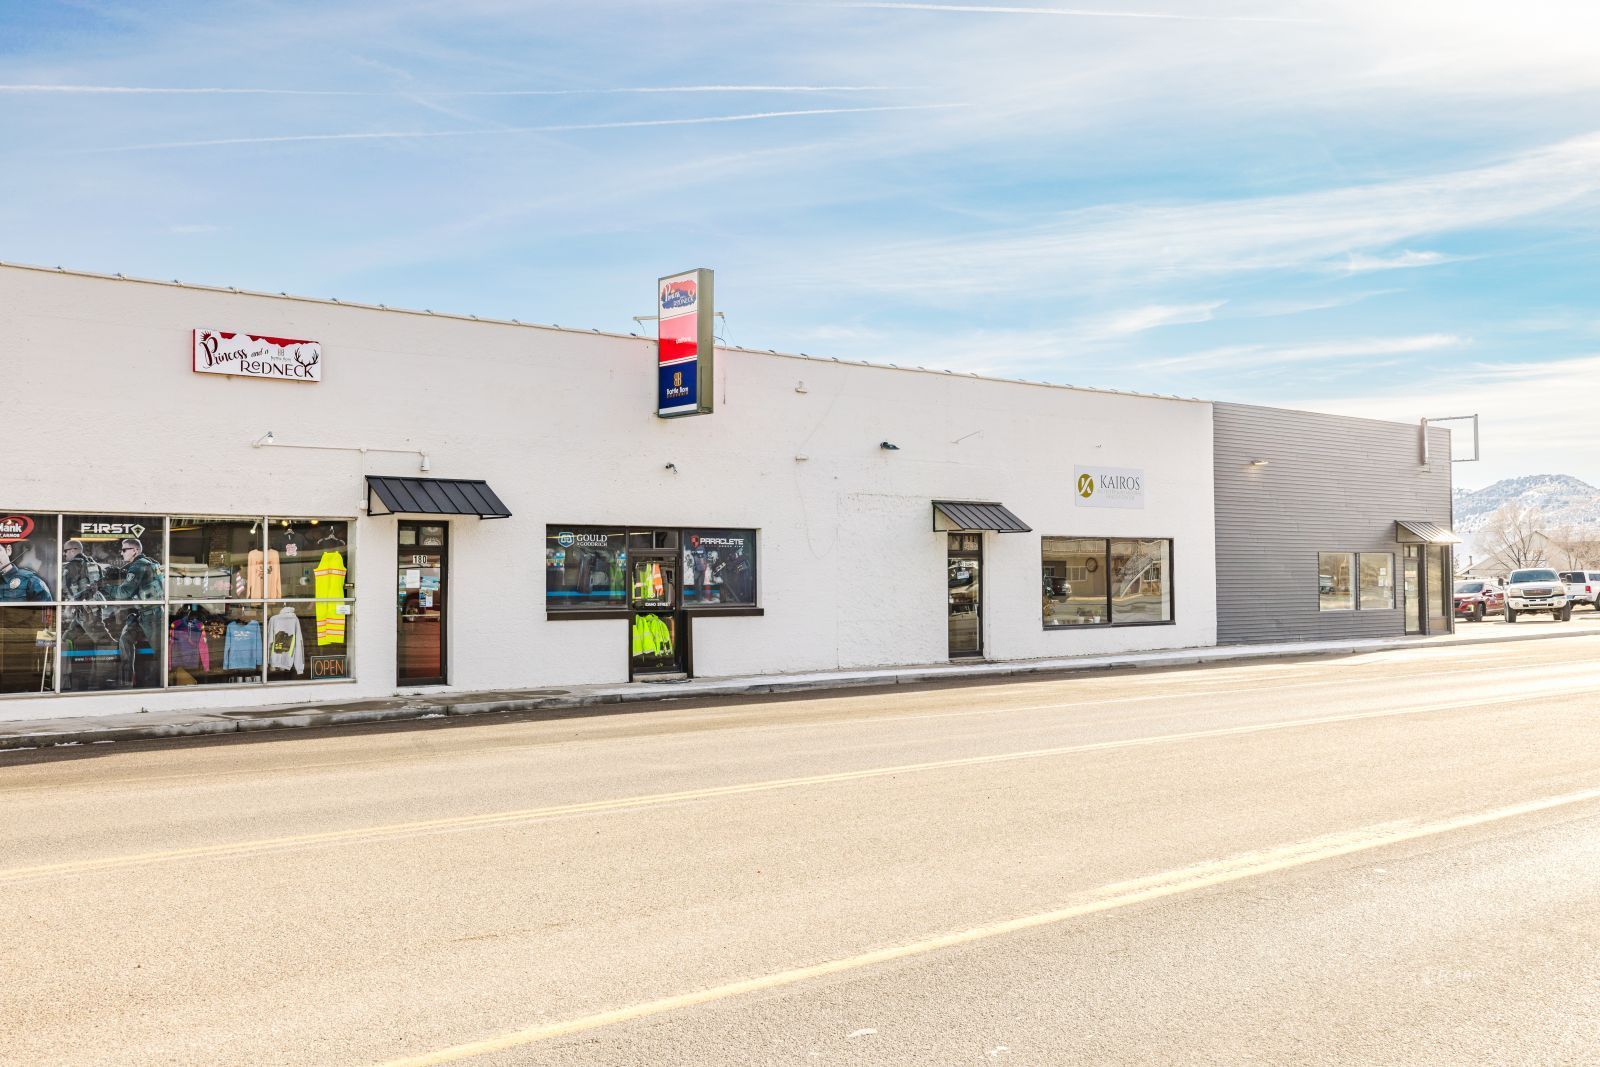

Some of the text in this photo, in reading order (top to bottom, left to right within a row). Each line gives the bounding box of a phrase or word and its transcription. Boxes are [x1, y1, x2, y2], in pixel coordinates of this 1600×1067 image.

[200, 336, 247, 369] Princess
[1100, 474, 1140, 491] KAIROS
[0, 522, 22, 533] lank
[576, 533, 608, 542] GOULD
[700, 537, 744, 545] PARACLETE
[413, 555, 427, 564] 180
[313, 660, 344, 676] OPEN
